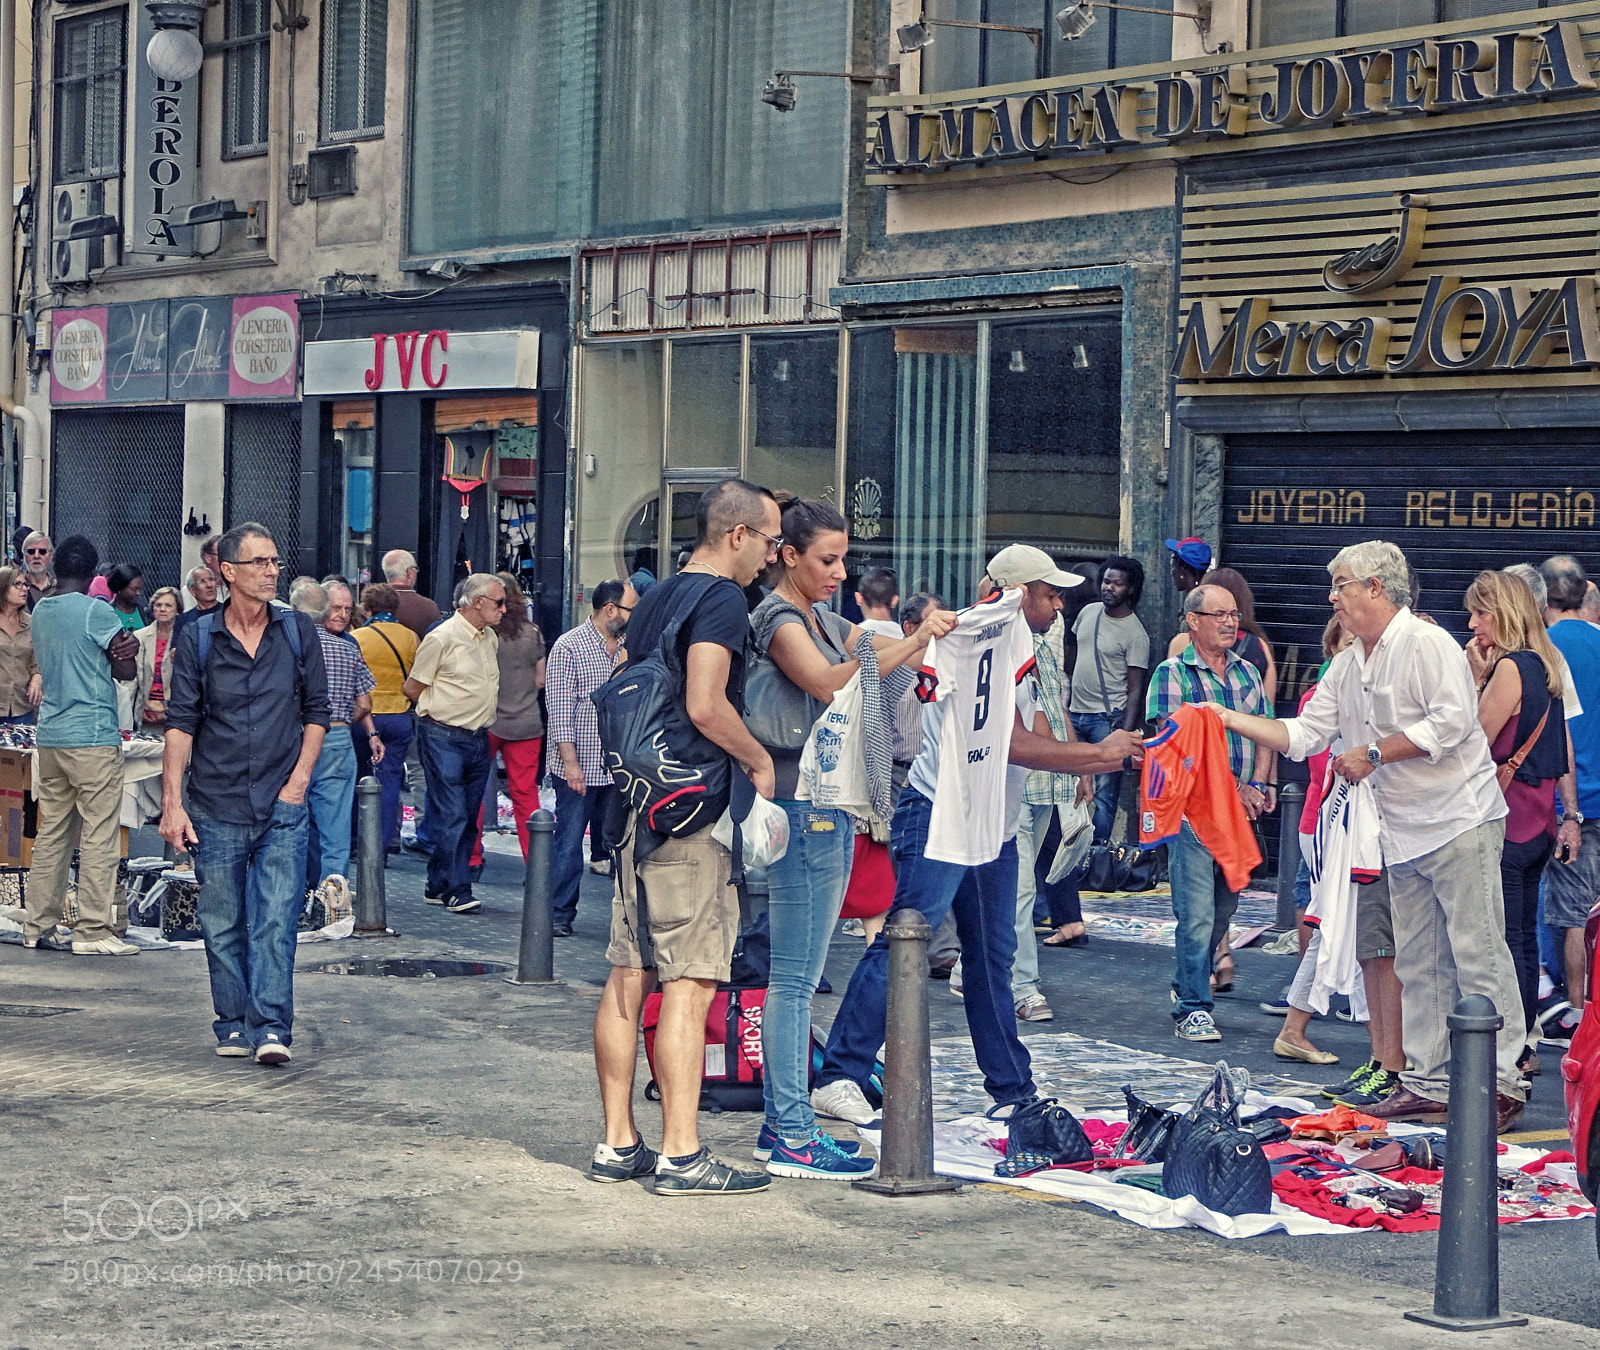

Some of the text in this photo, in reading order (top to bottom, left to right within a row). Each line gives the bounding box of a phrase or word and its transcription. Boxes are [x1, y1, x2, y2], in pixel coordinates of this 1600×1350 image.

[865, 22, 1578, 168] ALMACEN DE JOYERIA
[60, 330, 98, 345] LENCERIA
[235, 338, 293, 355] CORSETERIA
[242, 319, 288, 334] LENCERIA
[1170, 275, 1585, 378] Merca JOYA
[249, 356, 278, 374] BAÑO
[364, 330, 448, 390] JVC
[973, 648, 994, 731] 9
[743, 1005, 764, 1064] SPORT
